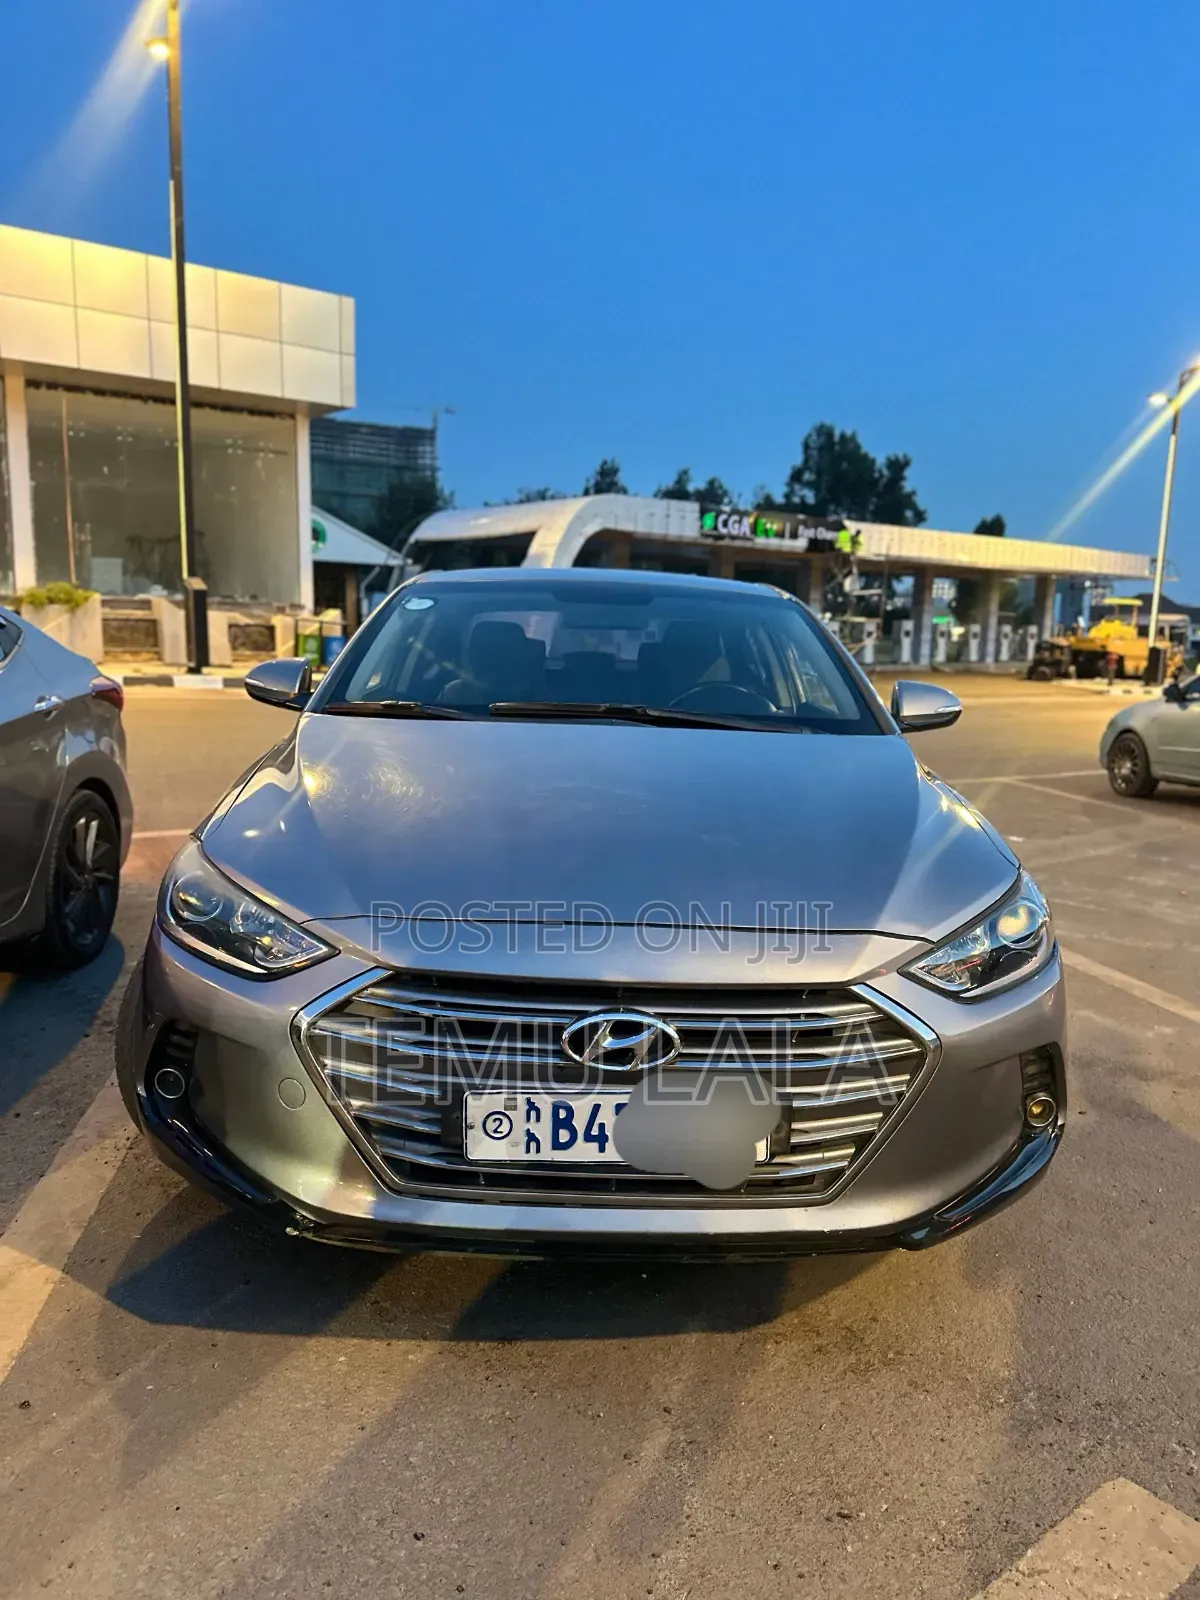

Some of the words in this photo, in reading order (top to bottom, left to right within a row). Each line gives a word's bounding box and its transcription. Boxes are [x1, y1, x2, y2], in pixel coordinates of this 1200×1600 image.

[716, 511, 751, 537] CGA
[492, 1117, 504, 1134] 2
[551, 1100, 629, 1154] B4
